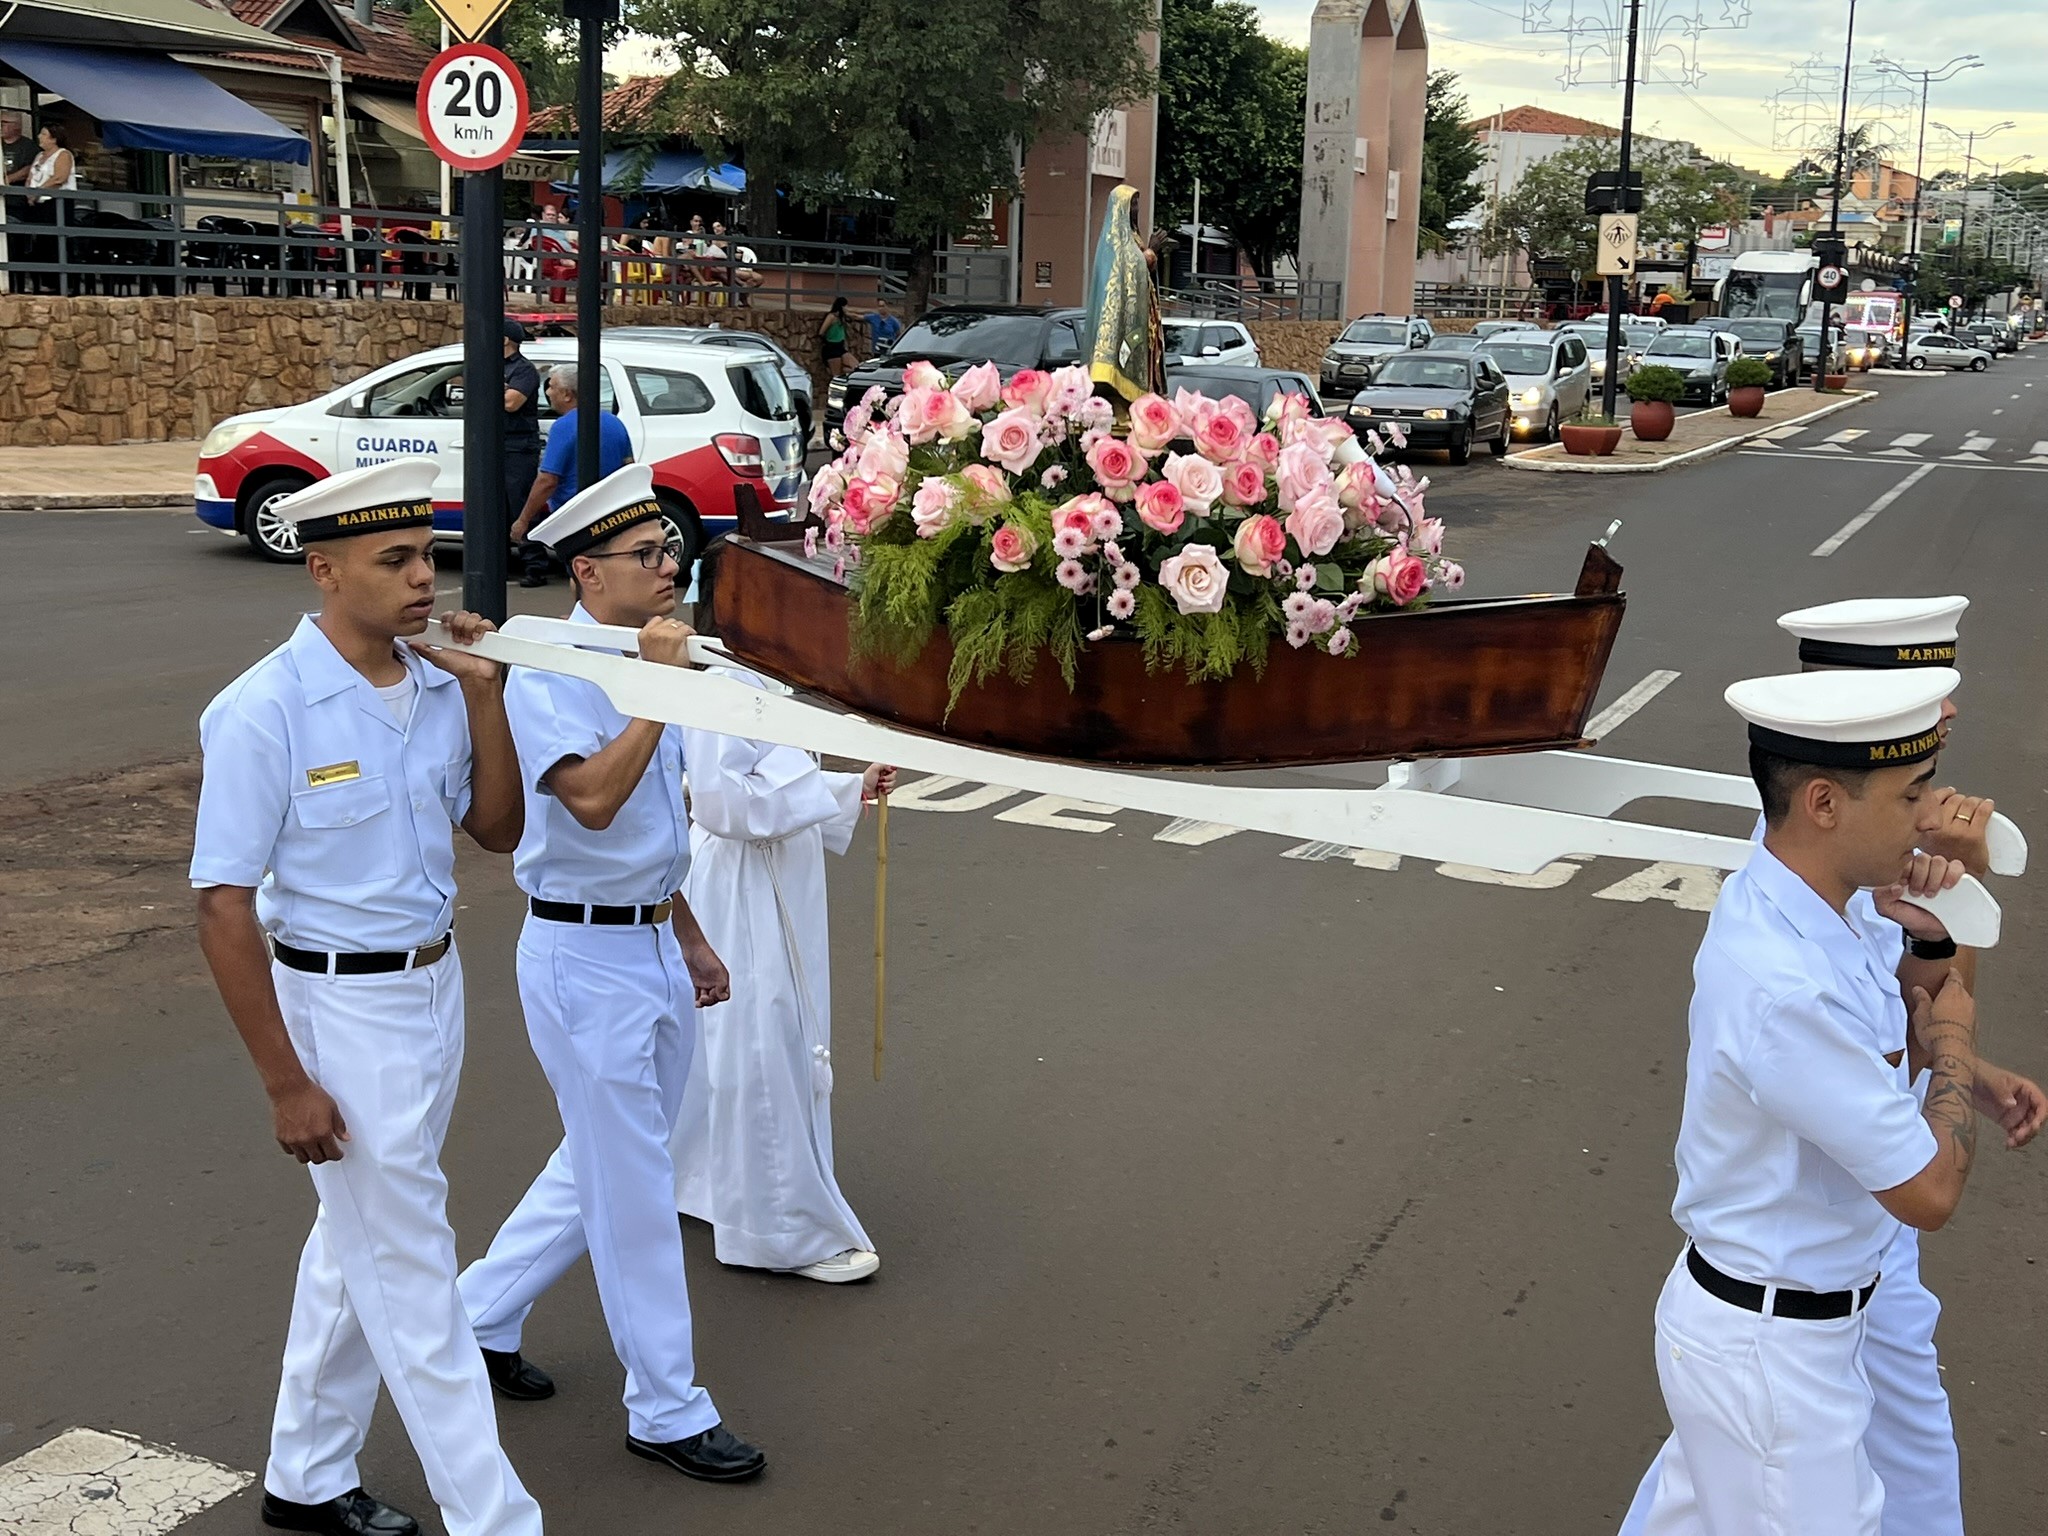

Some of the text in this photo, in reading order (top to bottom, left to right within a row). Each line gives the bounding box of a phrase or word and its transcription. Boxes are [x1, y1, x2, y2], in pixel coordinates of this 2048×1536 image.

[444, 69, 502, 119] 20
[454, 123, 493, 140] km/h
[1823, 270, 1837, 280] 40
[356, 436, 439, 454] GUARDA
[337, 506, 412, 526] MARINHA
[590, 505, 647, 536] MARINHA
[1869, 730, 1939, 760] MARINHA
